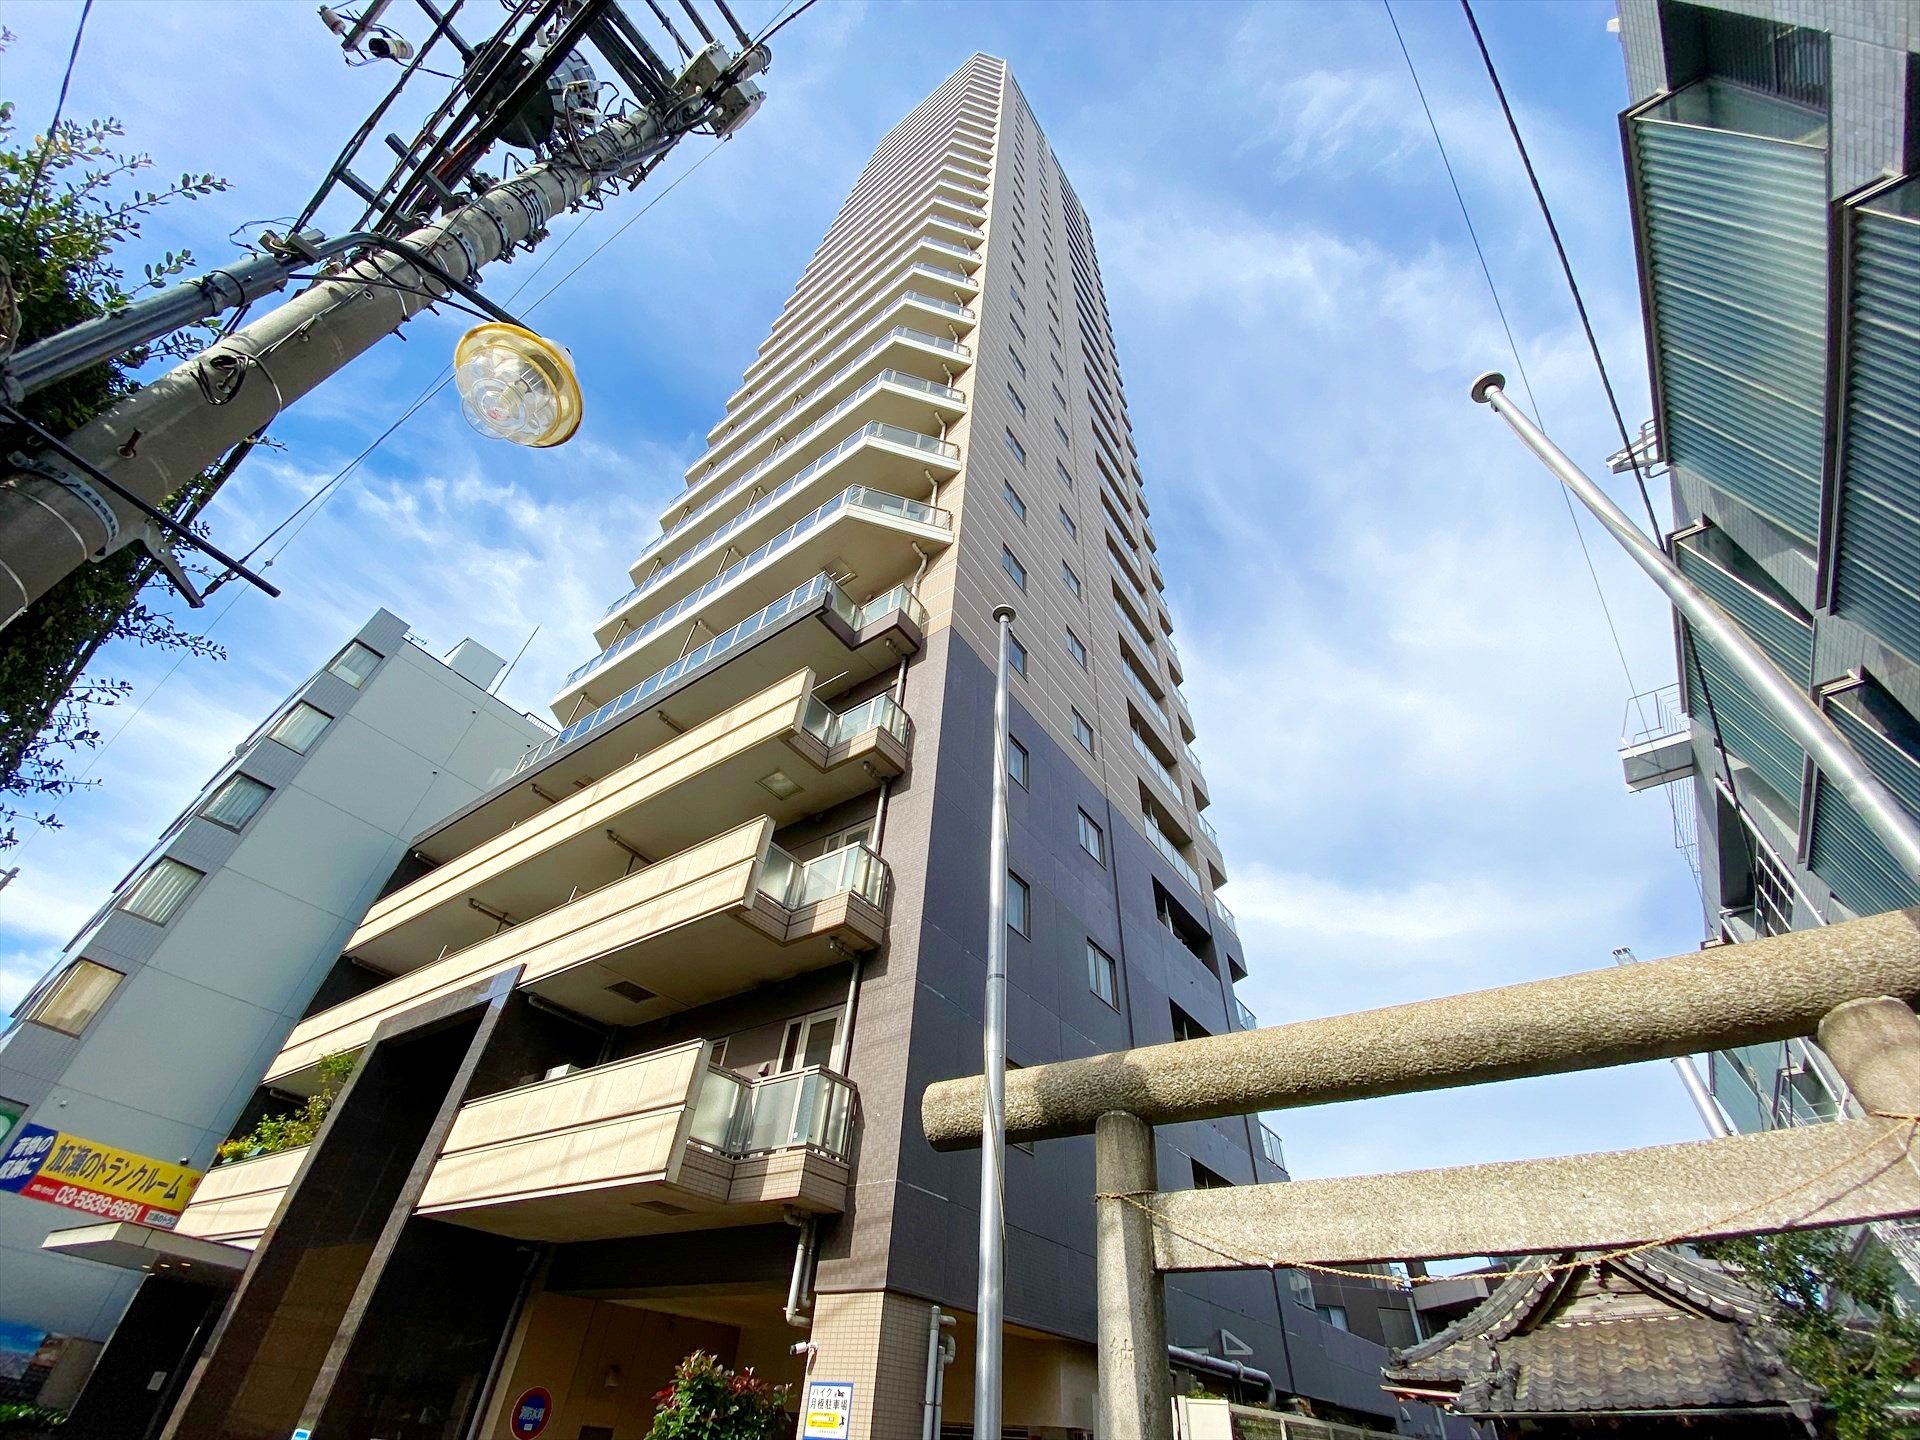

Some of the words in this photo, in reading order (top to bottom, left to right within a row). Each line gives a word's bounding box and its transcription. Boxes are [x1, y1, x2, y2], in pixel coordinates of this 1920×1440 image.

[46, 1140, 183, 1200] 加瀬のトランクルーム
[54, 1185, 145, 1223] 03-5839-6661
[810, 1397, 848, 1411] 月極駐車場
[812, 1387, 833, 1398] バイク
